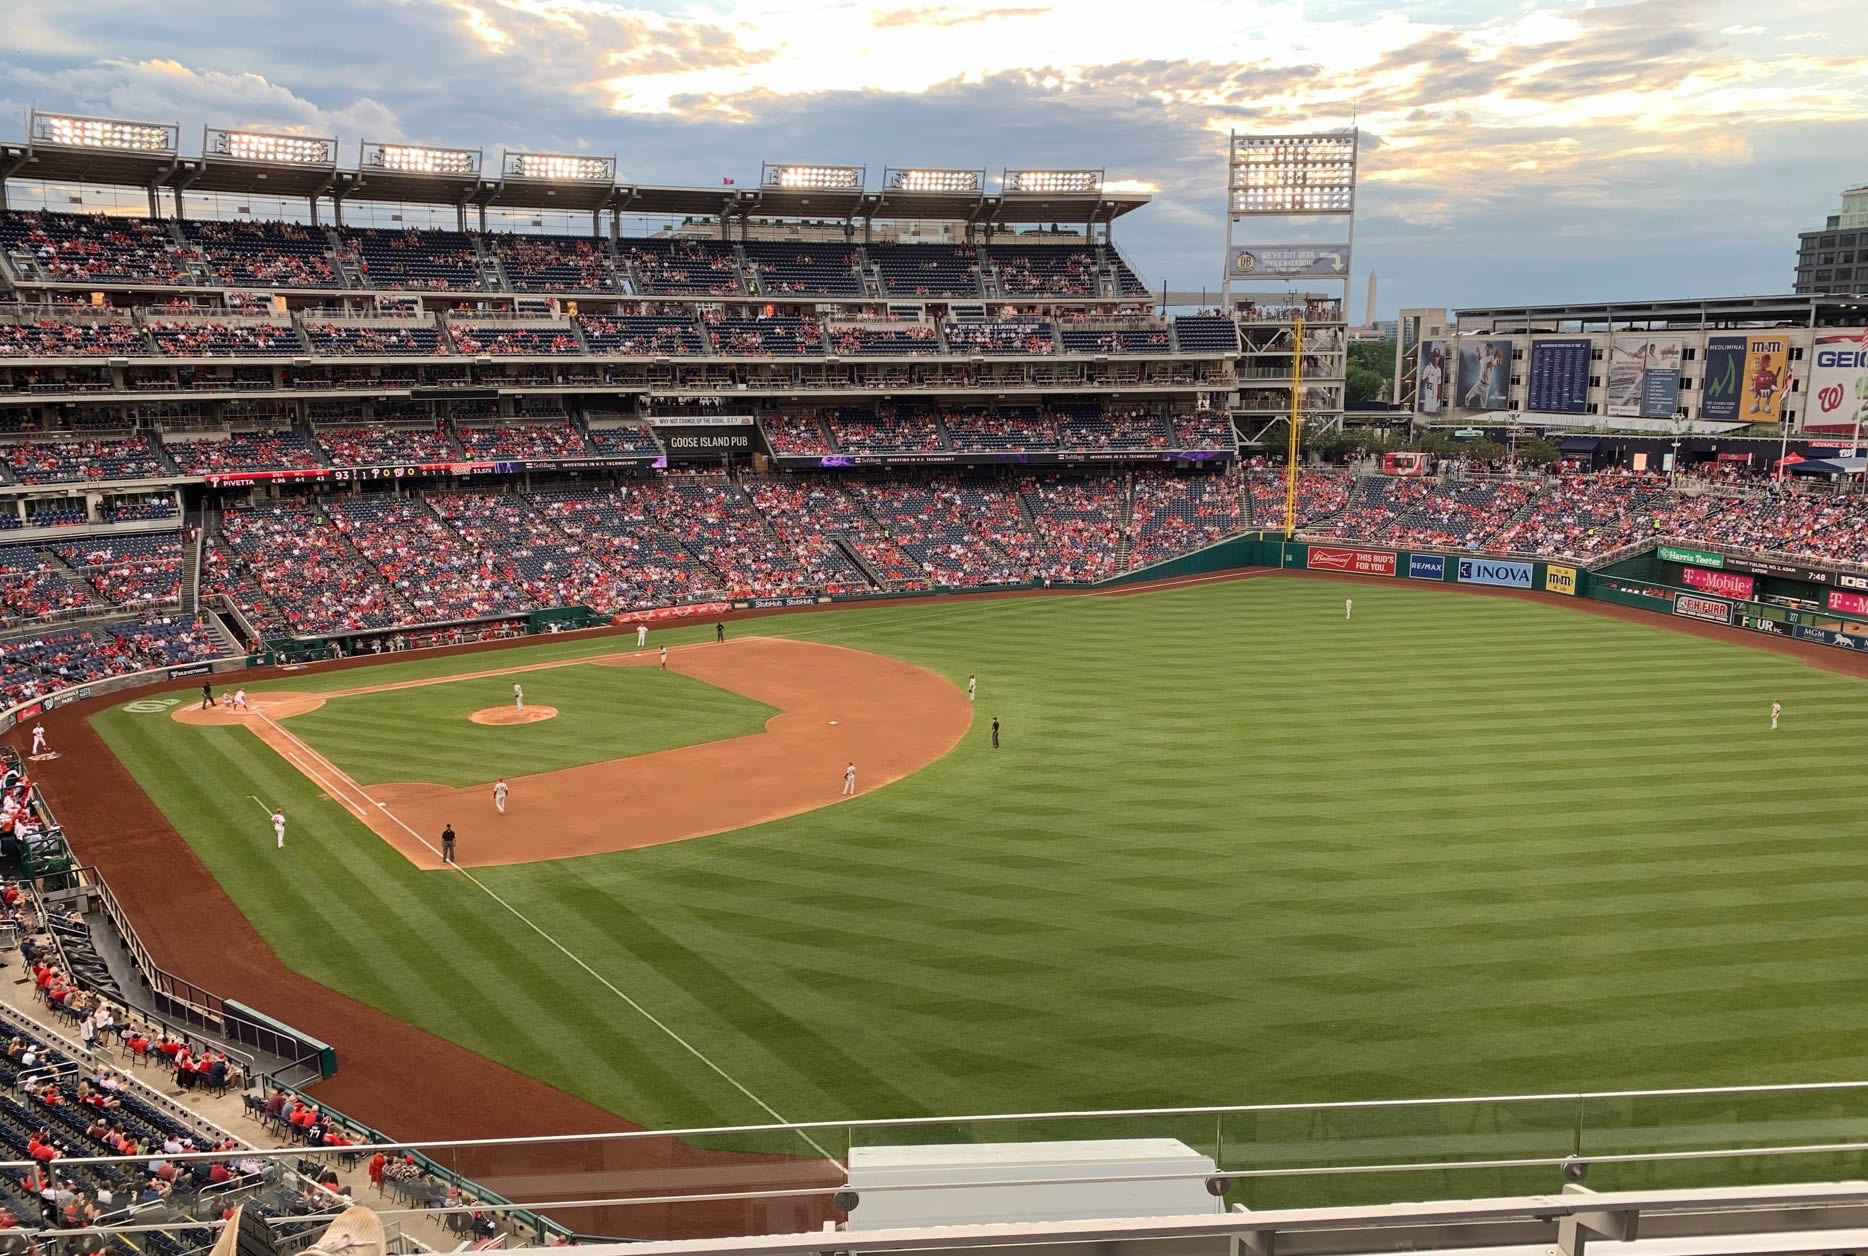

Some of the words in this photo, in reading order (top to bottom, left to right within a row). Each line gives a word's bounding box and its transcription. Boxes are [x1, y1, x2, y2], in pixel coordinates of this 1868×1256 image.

[671, 437, 698, 447] GOOSE
[700, 437, 730, 447] ISLAND
[731, 436, 748, 446] PUB
[335, 471, 349, 480] 93
[1356, 553, 1372, 562] THIS
[1373, 554, 1394, 563] BUD'S
[1669, 552, 1694, 561] Harris
[1695, 555, 1721, 565] Teeter
[1371, 563, 1386, 571] YOU.
[1411, 563, 1442, 571] RE/MAX
[1477, 565, 1529, 582] INOVA
[1808, 572, 1826, 581] 7:48
[755, 600, 783, 608] StubHub
[786, 598, 814, 606] StubHub
[1703, 603, 1726, 615] FURR
[1789, 613, 1798, 621] 377
[1804, 629, 1824, 638] MGM
[54, 690, 79, 701] NATIONALS
[309, 1129, 320, 1138] 77
